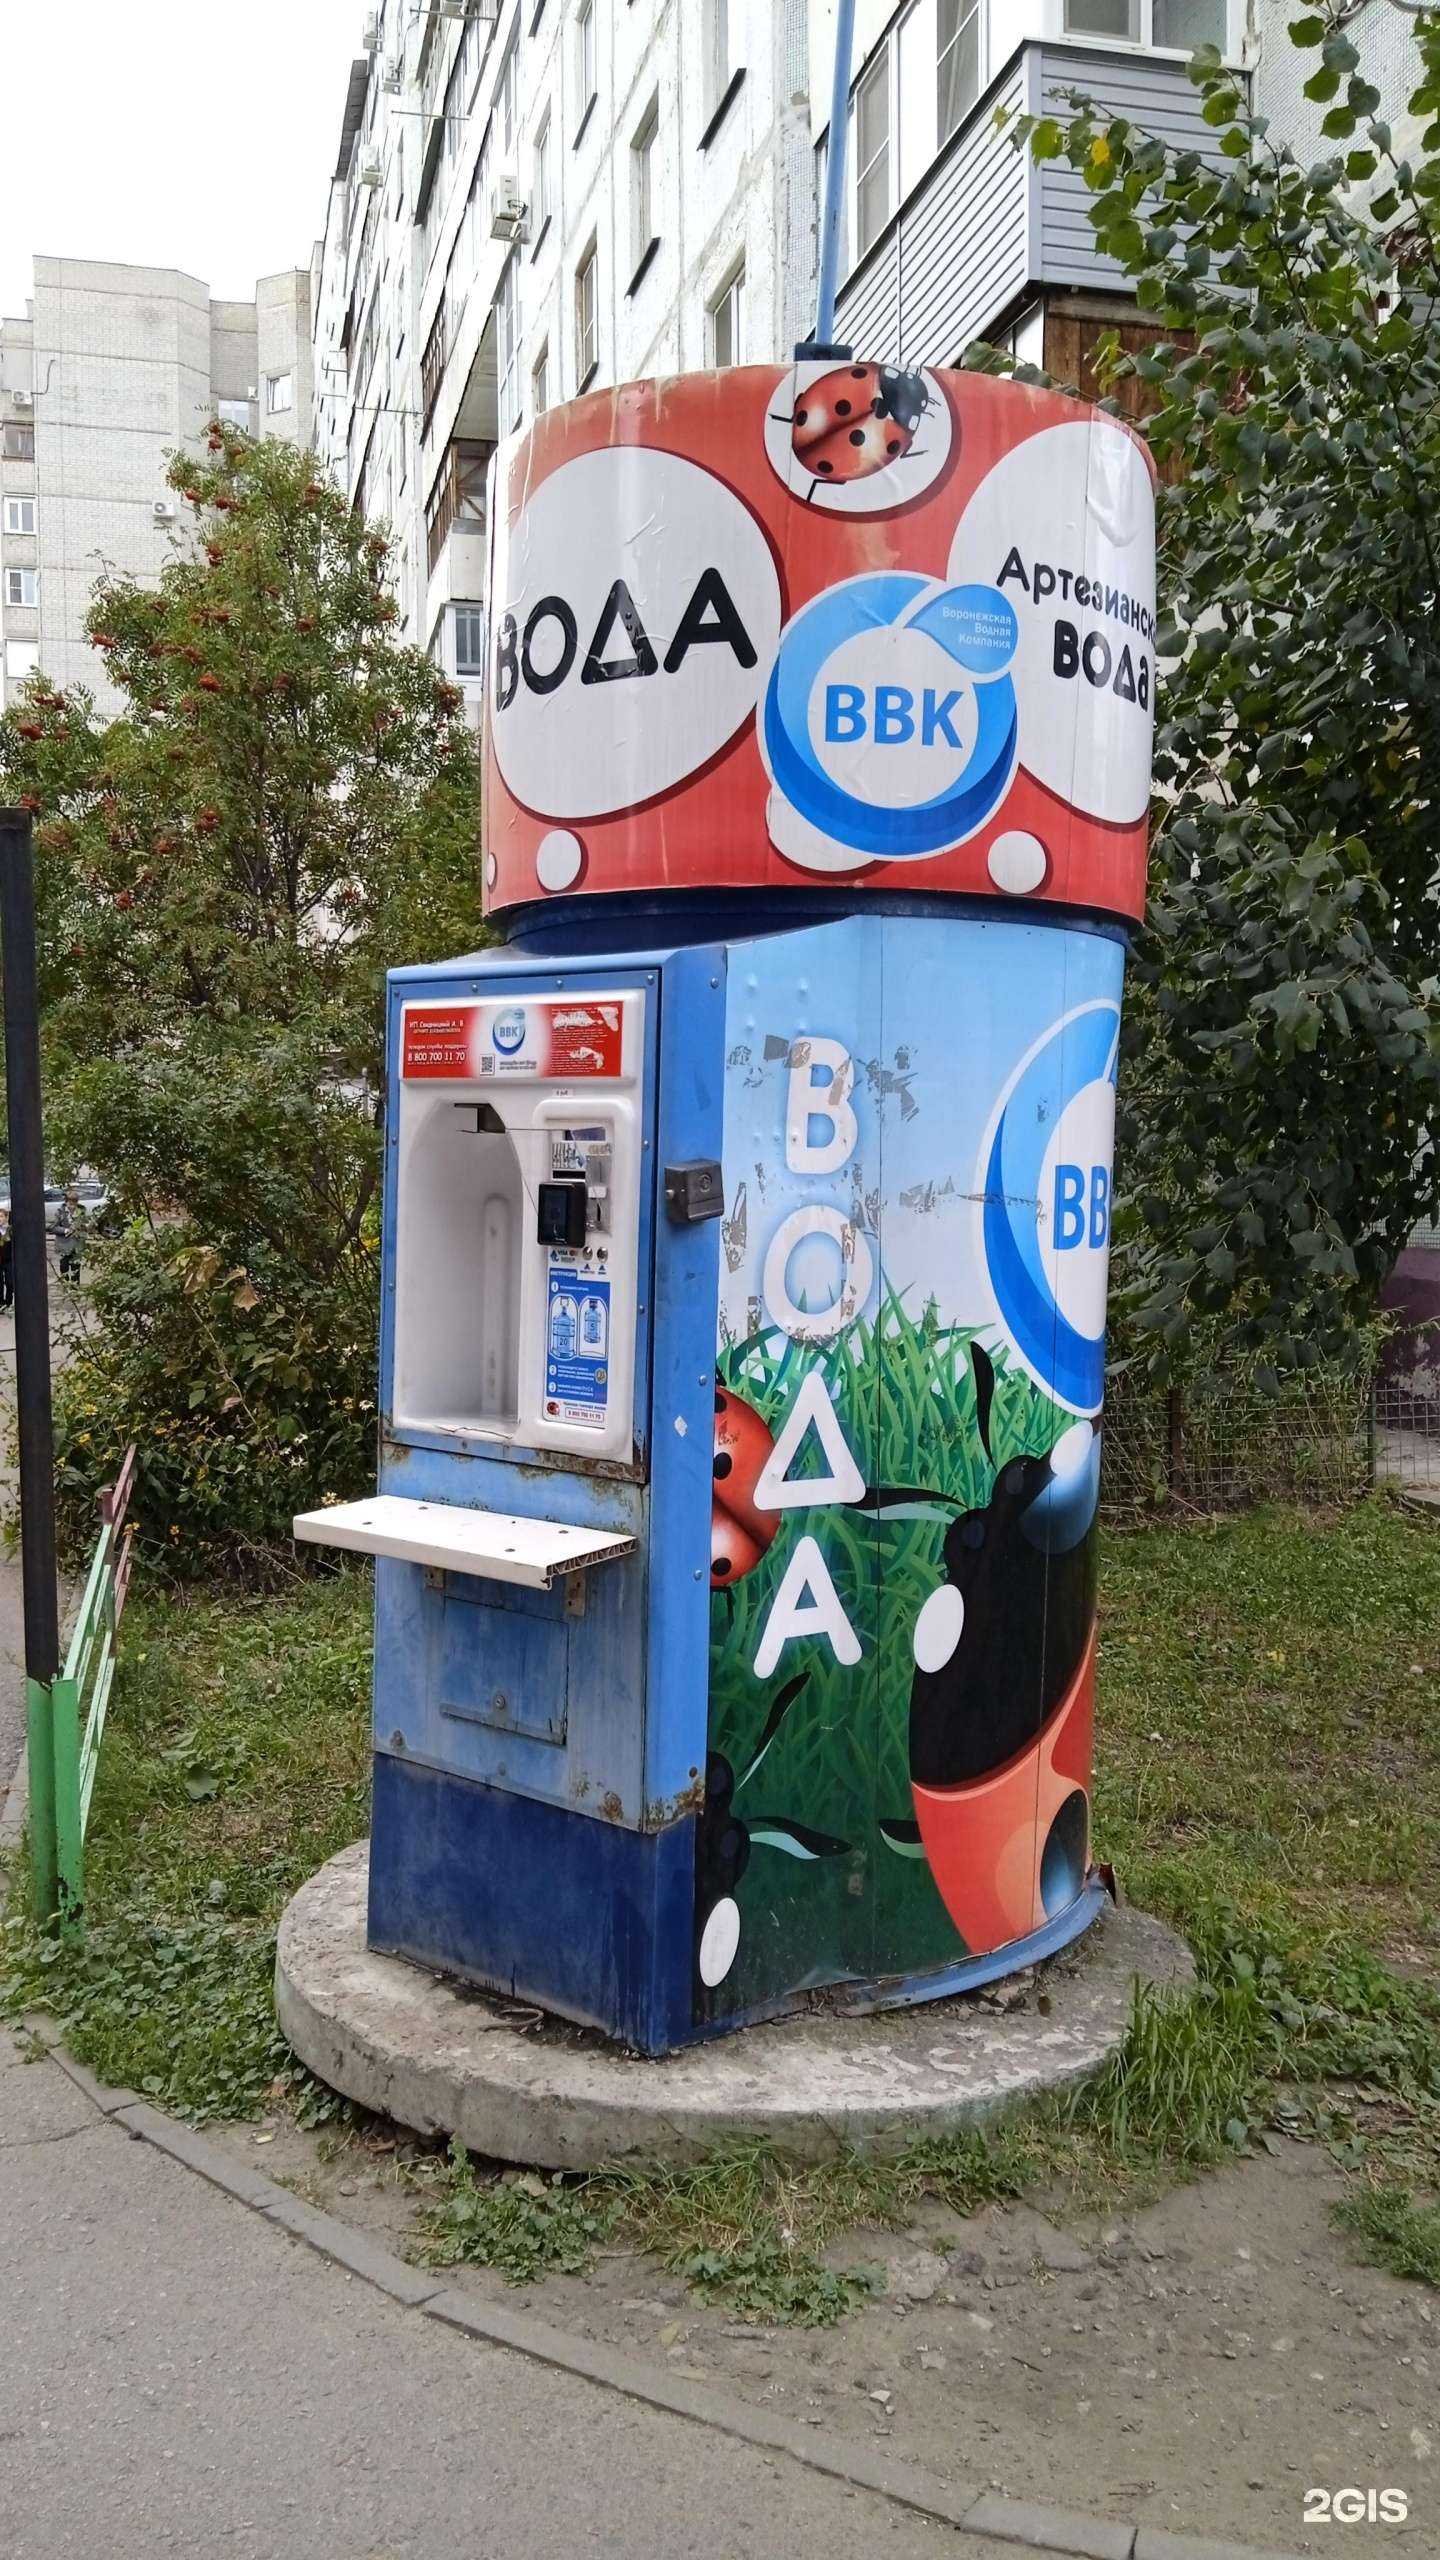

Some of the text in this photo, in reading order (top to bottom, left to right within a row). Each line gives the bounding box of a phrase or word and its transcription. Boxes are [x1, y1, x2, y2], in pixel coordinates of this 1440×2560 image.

[942, 607, 1012, 625] Воронежская
[974, 622, 1011, 637] Водная
[996, 546, 1157, 648] Артезианск
[496, 567, 758, 712] ВОДА
[824, 684, 963, 749] ВВК
[414, 1052, 427, 1061] 800
[429, 1051, 442, 1061] 700
[444, 1051, 452, 1060] 11
[456, 1051, 465, 1060] 70
[1053, 1164, 1110, 1250] ВВ
